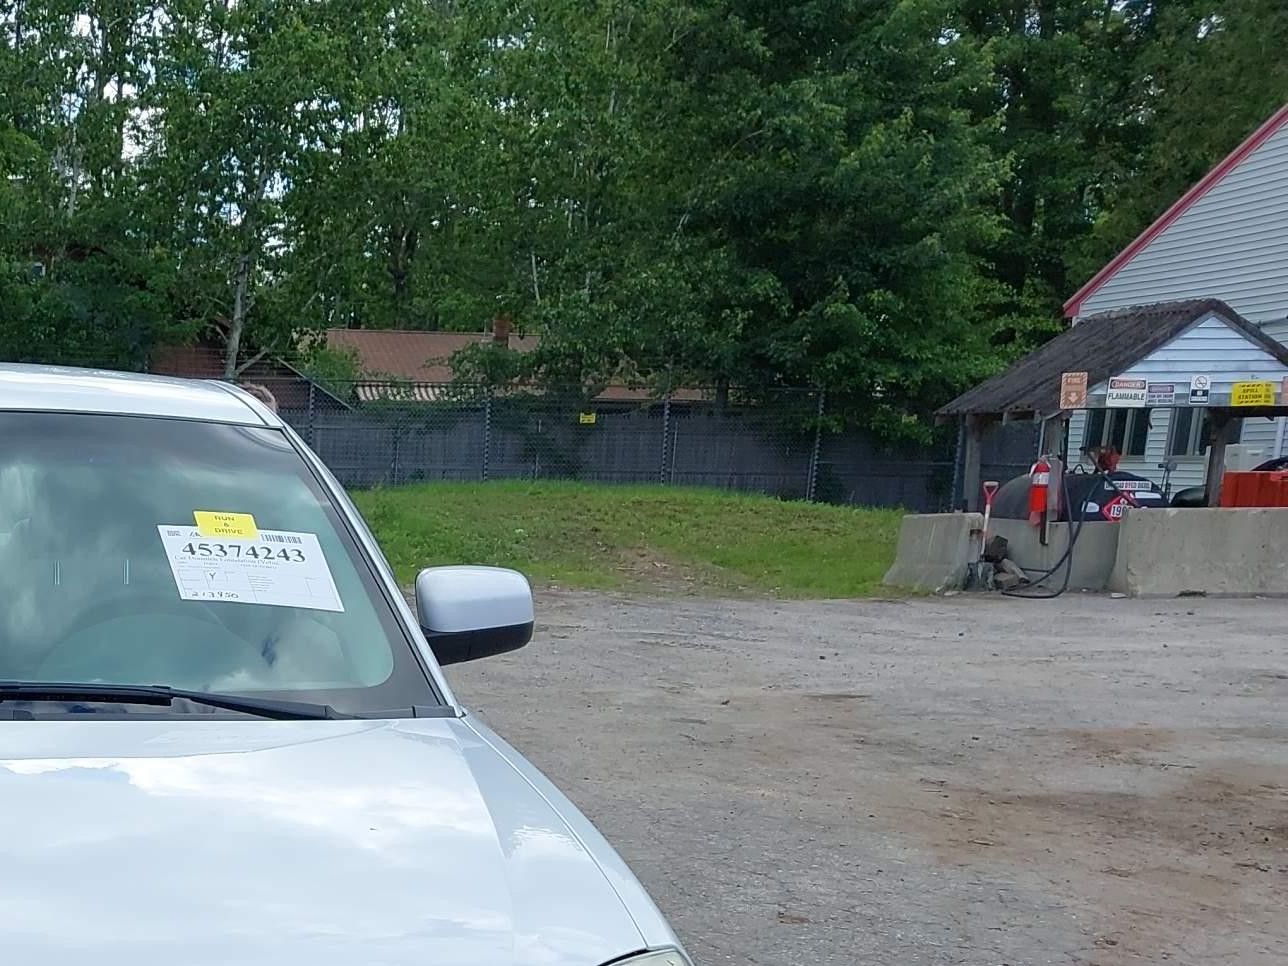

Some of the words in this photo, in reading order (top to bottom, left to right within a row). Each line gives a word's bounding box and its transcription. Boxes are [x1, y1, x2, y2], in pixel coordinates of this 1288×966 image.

[1108, 392, 1145, 401] FLAMMABLE
[214, 527, 244, 535] DRIVE
[182, 541, 306, 564] 45374243
